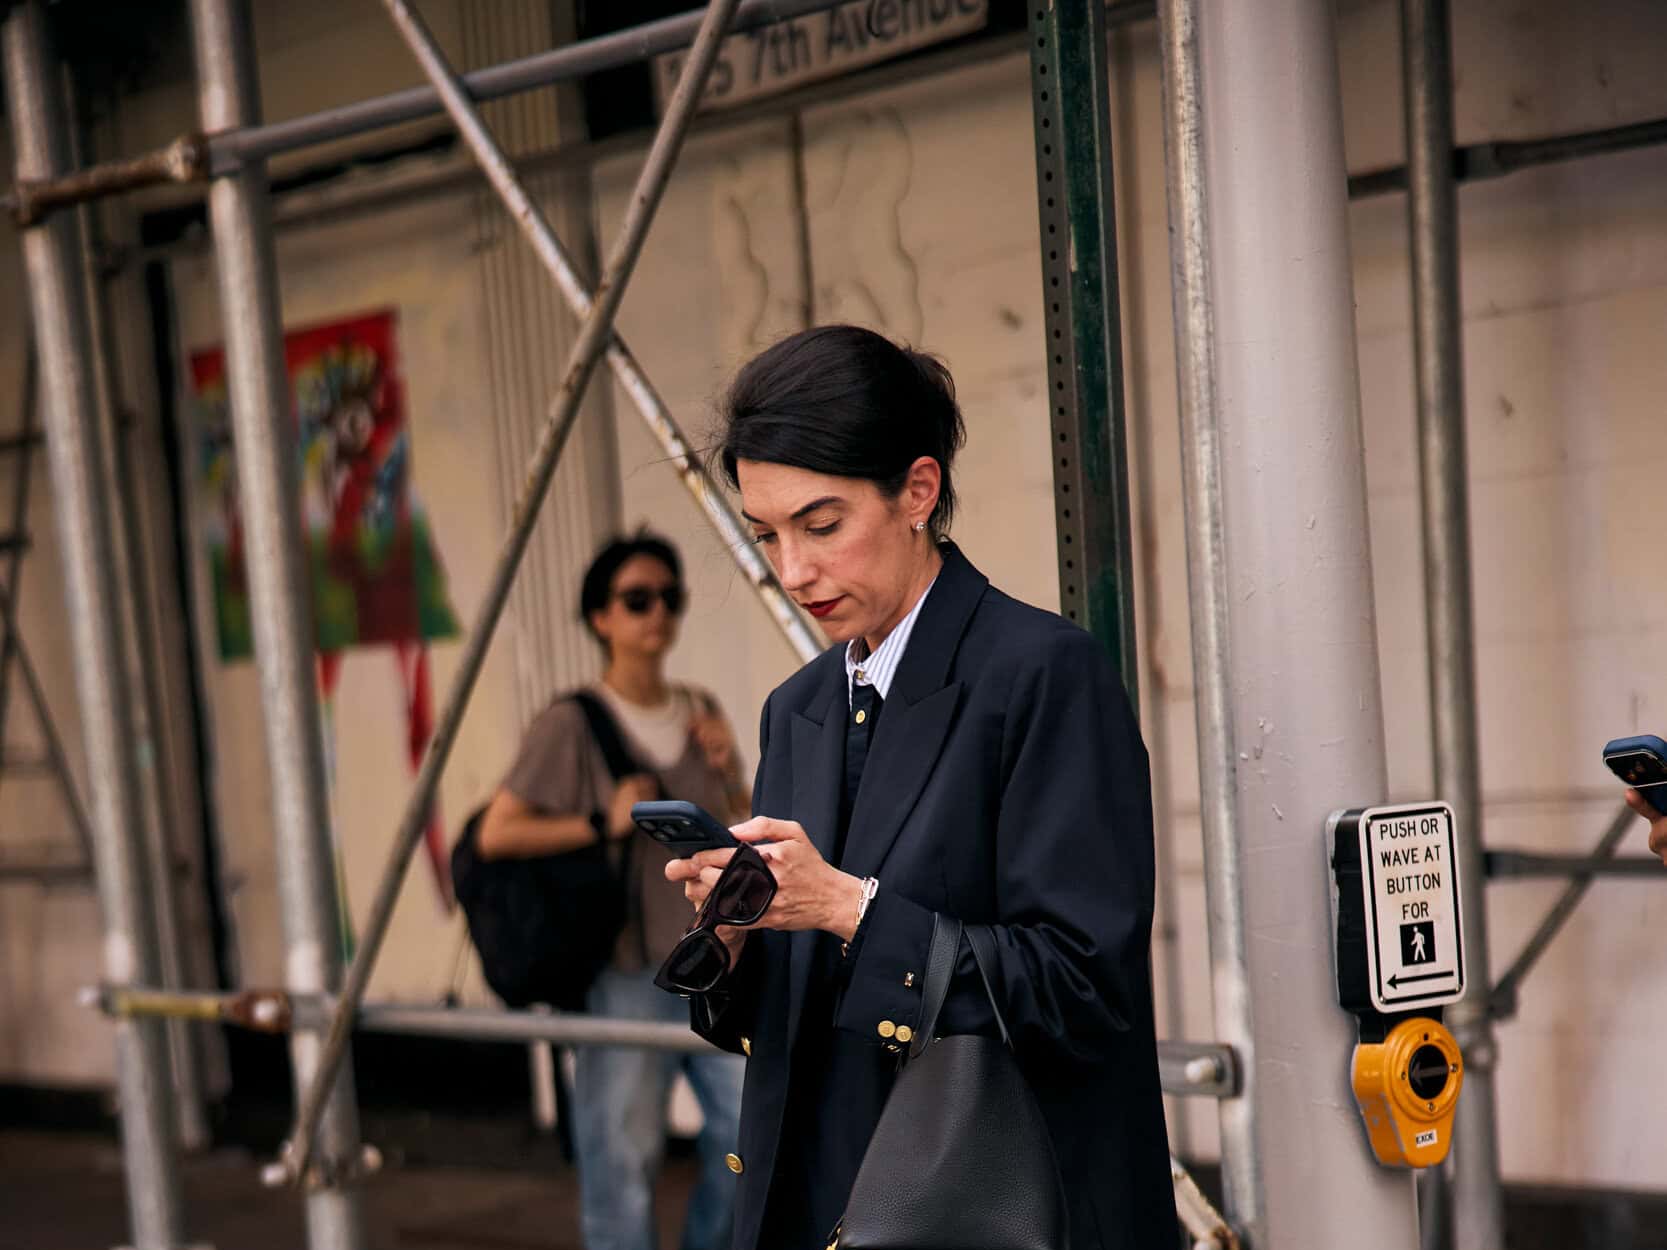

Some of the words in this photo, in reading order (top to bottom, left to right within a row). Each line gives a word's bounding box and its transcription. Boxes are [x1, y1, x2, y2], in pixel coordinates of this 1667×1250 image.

[747, 22, 811, 84] 7th
[1380, 820, 1417, 840] PUSH
[1420, 818, 1439, 835] OR
[1380, 847, 1419, 868] WAVE
[1424, 845, 1441, 861] AT
[1386, 873, 1441, 895] BUTTON
[1402, 901, 1429, 920] FOR
